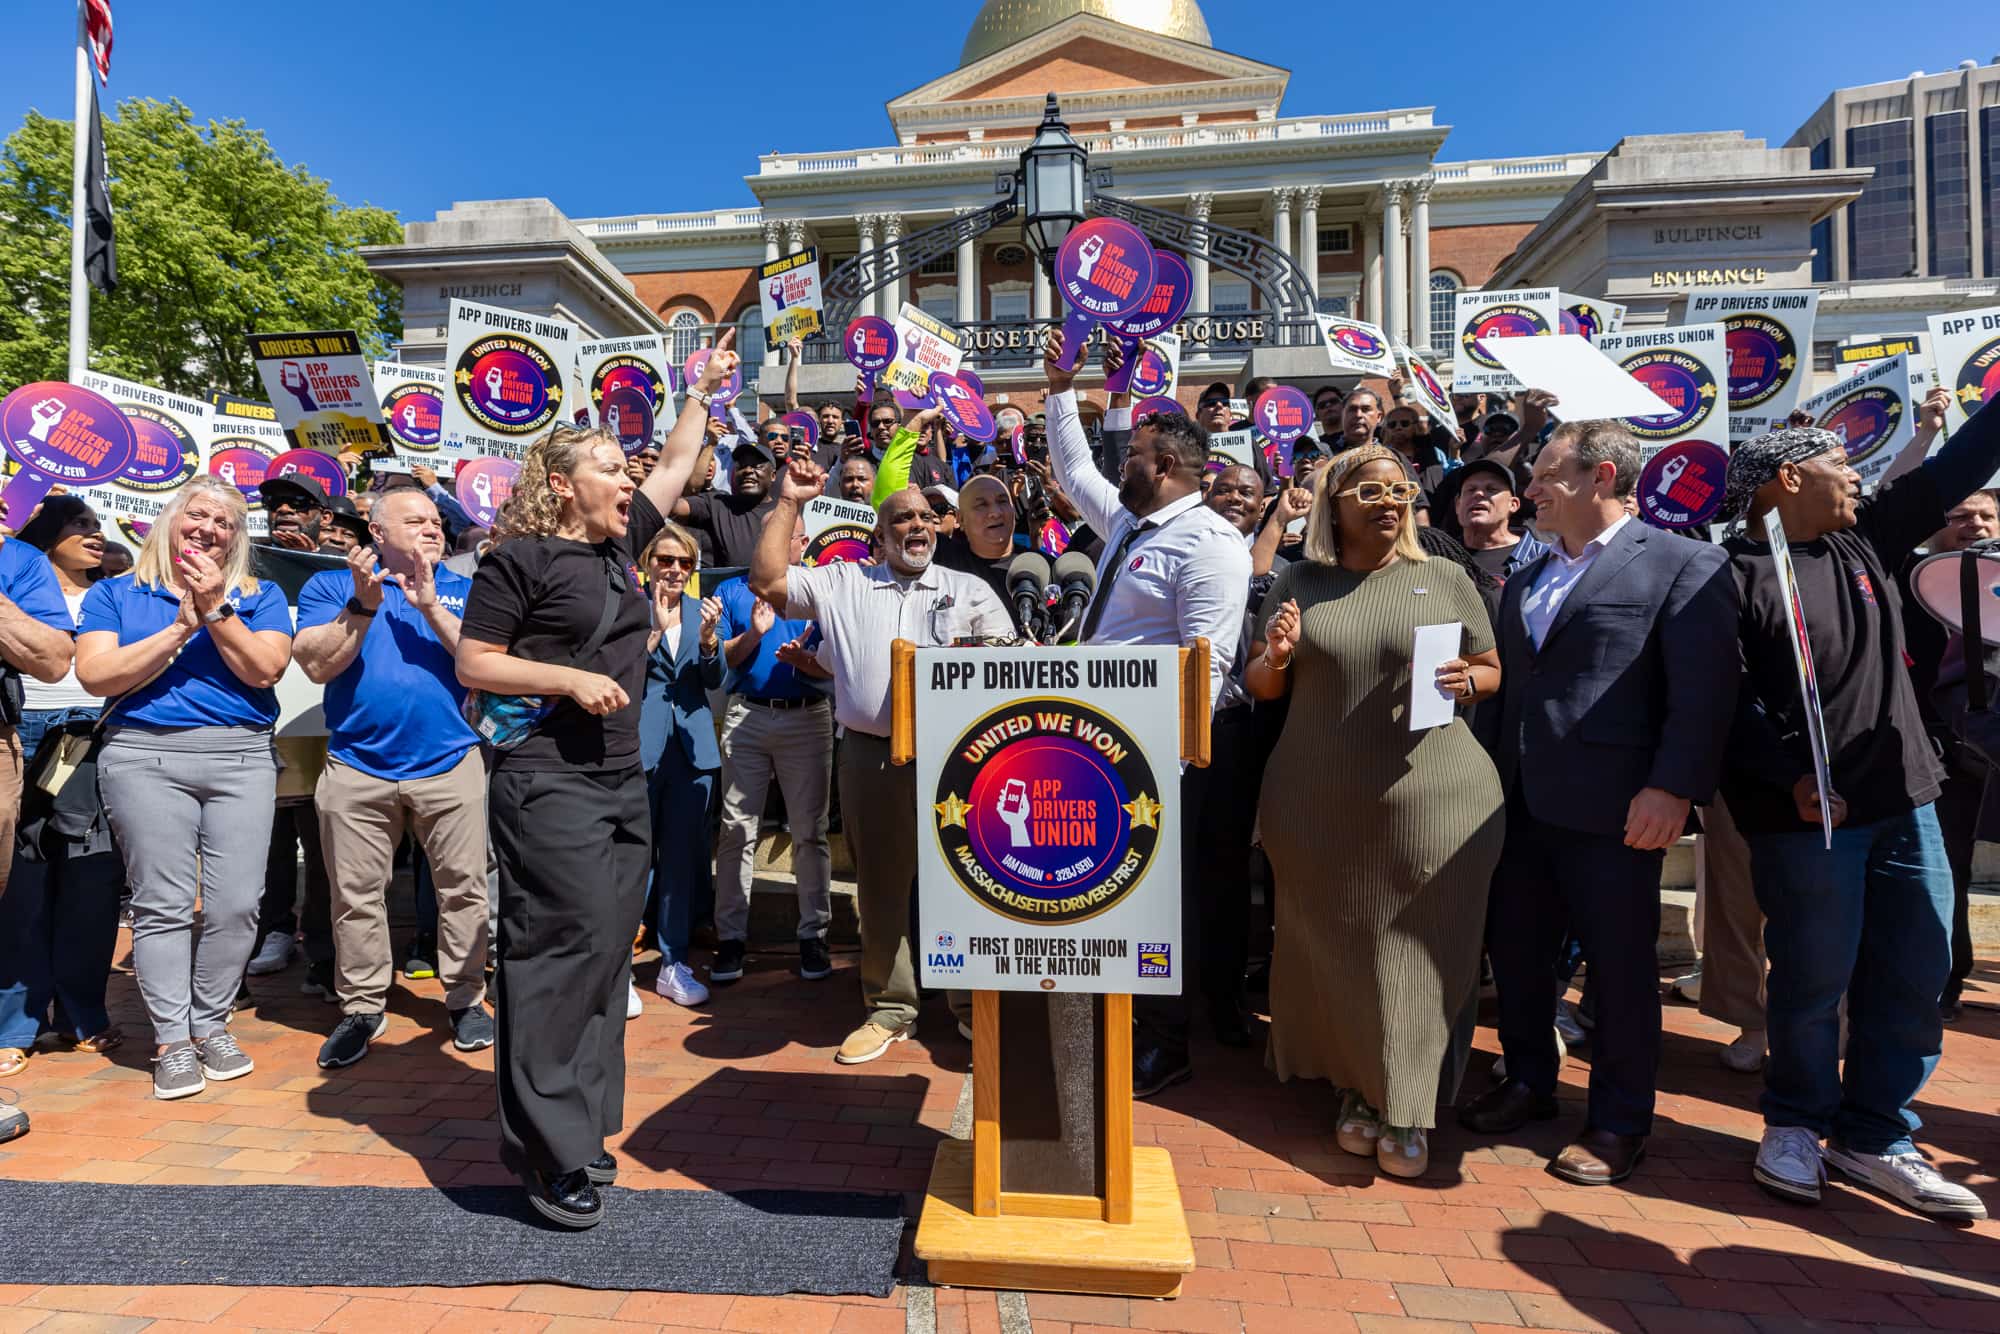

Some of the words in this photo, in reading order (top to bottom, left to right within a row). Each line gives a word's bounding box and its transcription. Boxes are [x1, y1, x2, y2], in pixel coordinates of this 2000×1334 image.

[1104, 242, 1125, 259] APP
[764, 258, 791, 277] DRIVERS
[1099, 255, 1138, 284] DRIVERS
[1652, 267, 1767, 286] ENTRANCE
[785, 277, 812, 293] DRIVERS
[1090, 267, 1133, 300] UNION
[786, 289, 806, 302] UNION
[1463, 296, 1480, 305] APP
[1483, 294, 1520, 304] DRIVERS
[1523, 291, 1551, 301] UNION
[1695, 297, 1718, 310] APP
[1721, 296, 1769, 310] DRIVERS
[1772, 295, 1808, 309] UNION
[458, 306, 481, 322] APP
[485, 312, 531, 333] DRIVERS
[535, 323, 568, 341] UNION
[1173, 320, 1265, 341] HOUSE
[1744, 319, 1761, 329] WE
[1762, 322, 1786, 342] WON
[1942, 318, 1975, 335] APP
[259, 339, 314, 357] DRIVERS
[315, 337, 343, 353] WIN
[582, 345, 597, 356] APP
[599, 341, 632, 354] DRIVERS
[633, 339, 657, 350] UNION
[924, 335, 939, 347] APP
[1600, 338, 1622, 350] APP
[1626, 333, 1674, 348] DRIVERS
[1678, 329, 1714, 343] UNION
[472, 340, 507, 357] UNITED
[509, 340, 525, 353] WE
[527, 347, 550, 371] WON
[919, 352, 940, 369] UNION
[921, 345, 951, 366] DRIVERS
[1842, 345, 1884, 361] DRIVERS
[305, 363, 328, 376] APP
[1653, 354, 1672, 362] WE
[1673, 355, 1700, 373] WON
[1732, 367, 1764, 378] UNION
[311, 375, 360, 390] DRIVERS
[381, 366, 398, 376] APP
[401, 369, 435, 381] DRIVERS
[503, 370, 518, 379] APP
[1806, 396, 1824, 411] APP
[1826, 376, 1865, 401] DRIVERS
[1868, 358, 1899, 381] UNION
[82, 376, 108, 390] APP
[113, 383, 164, 406] DRIVERS
[168, 398, 203, 416] UNION
[315, 389, 352, 403] UNION
[503, 390, 533, 405] UNION
[67, 409, 95, 427] APP
[225, 402, 276, 420] DRIVERS
[60, 420, 113, 453] DRIVERS
[213, 423, 255, 435] DRIVERS
[259, 426, 281, 437] UNIO
[48, 430, 105, 468] UNION
[443, 440, 463, 449] IAM
[466, 435, 485, 446] FIRST
[488, 439, 518, 452] DRIVERS
[1221, 435, 1245, 446] UNION
[487, 448, 500, 457] THE
[36, 457, 62, 474] 32BJ
[64, 466, 86, 477] SEIU
[89, 489, 112, 500] FIRST
[115, 494, 149, 507] DRIVERS
[103, 500, 112, 509] IN
[115, 502, 129, 512] THE
[811, 500, 832, 515] APP
[834, 504, 875, 524] DRIVERS
[819, 530, 851, 546] UNITED
[852, 530, 868, 542] WE
[931, 661, 976, 690] APP
[983, 660, 1079, 690] DRIVERS
[1087, 659, 1157, 688] UNION
[961, 714, 1033, 765] UNITED
[1035, 712, 1072, 732] WE
[1075, 718, 1129, 765] WON
[1032, 779, 1062, 799] APP
[1033, 799, 1097, 820] DRIVERS
[1033, 820, 1097, 846] UNION
[1001, 853, 1020, 872] IAM
[1017, 862, 1045, 881] UNION
[1055, 865, 1077, 882] 32BJ
[1075, 856, 1094, 875] SEIU
[955, 844, 1059, 914] MASSACHUSETTS
[1060, 878, 1118, 914] DRIVERS
[1112, 848, 1143, 886] FIRST
[969, 936, 1009, 956] FIRST
[1015, 937, 1076, 957] DRIVERS
[1081, 939, 1127, 958] UNION
[1139, 943, 1169, 953] 32BJ
[927, 953, 964, 968] IAM
[995, 957, 1010, 974] IN
[1015, 957, 1042, 975] THE
[1047, 957, 1101, 976] NATION
[1141, 966, 1168, 974] SEIU
